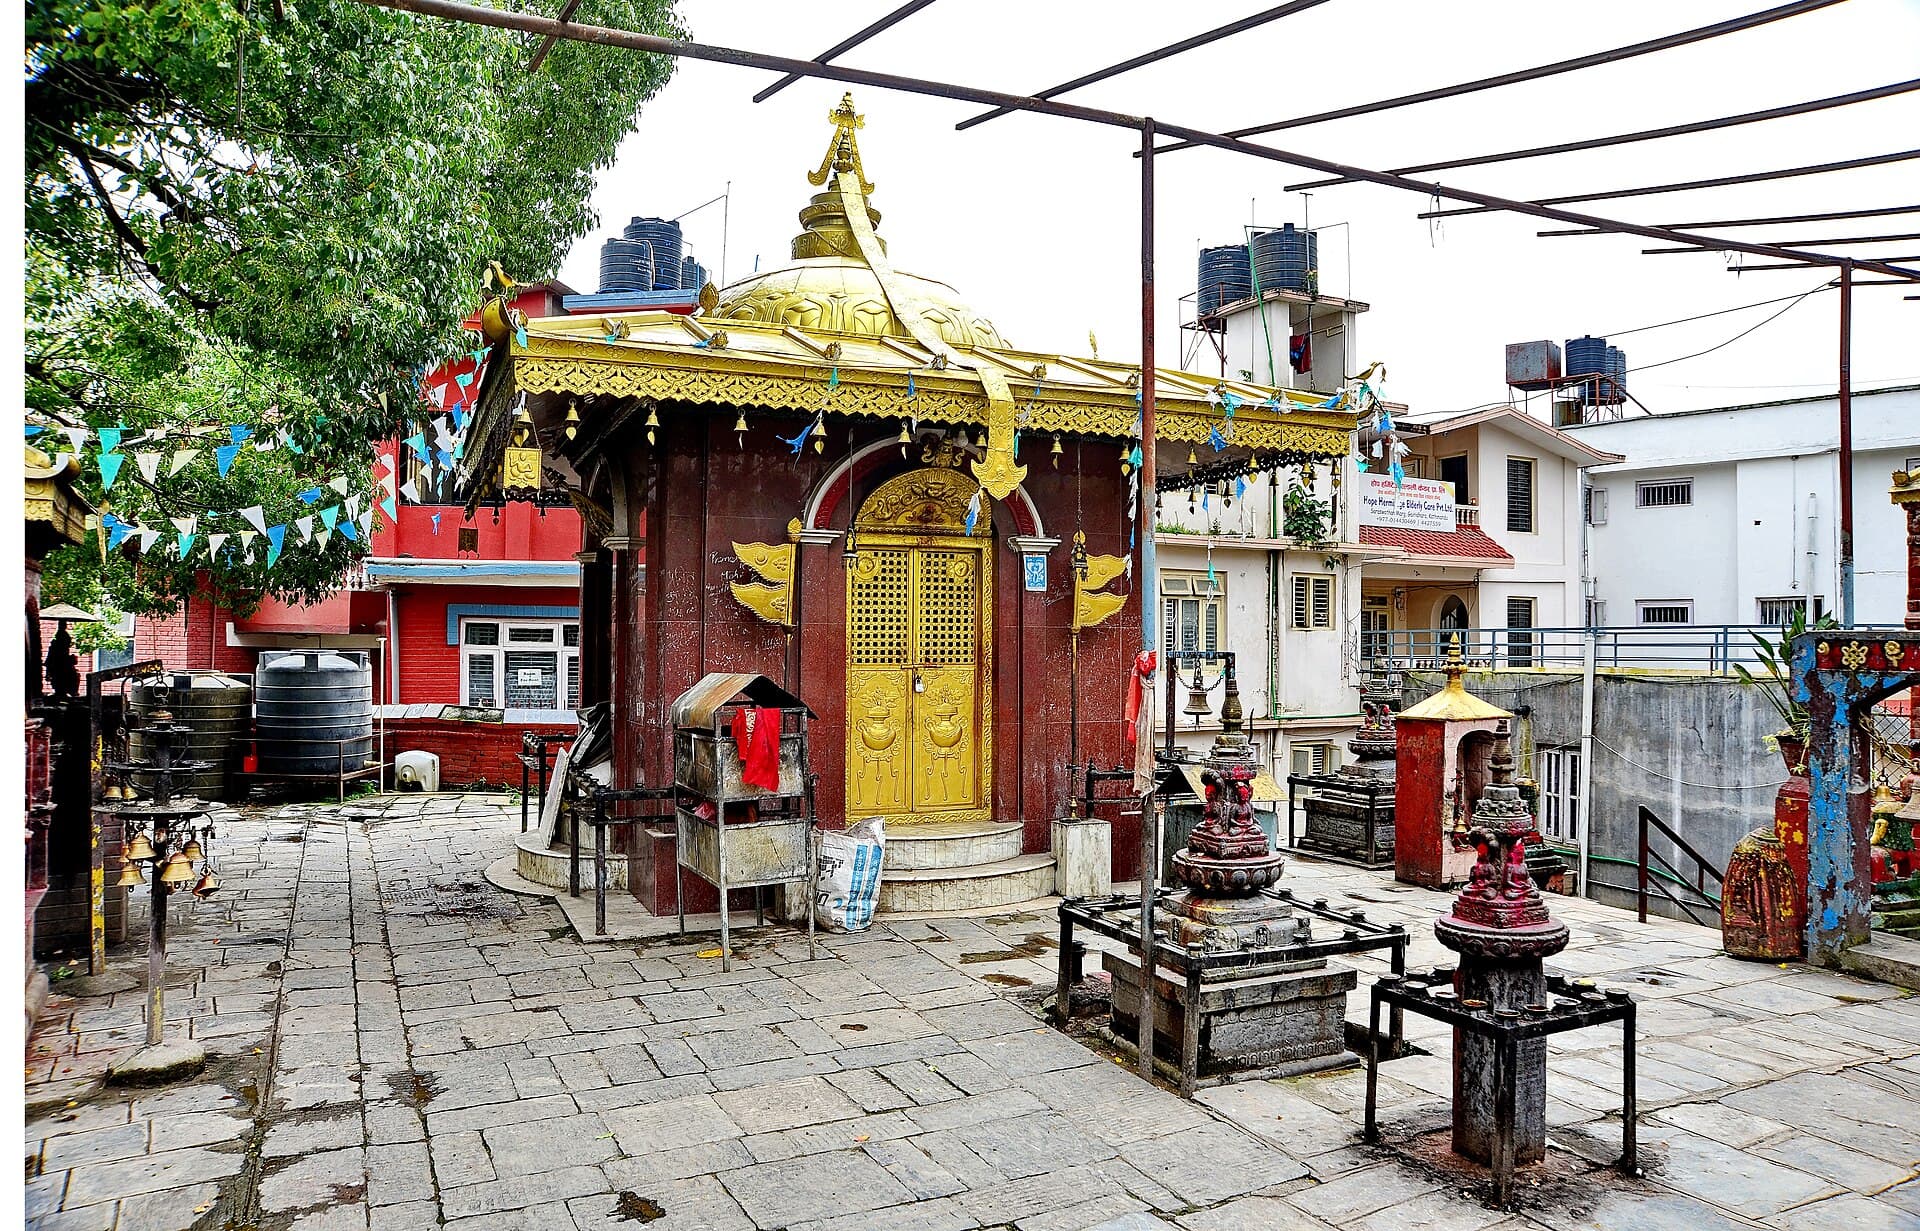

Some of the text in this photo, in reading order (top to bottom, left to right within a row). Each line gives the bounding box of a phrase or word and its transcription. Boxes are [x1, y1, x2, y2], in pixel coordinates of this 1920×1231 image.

[1363, 496, 1378, 507] Hope
[1378, 497, 1406, 510] Hermige
[1406, 499, 1423, 512] Elderly
[1423, 500, 1435, 511] Care
